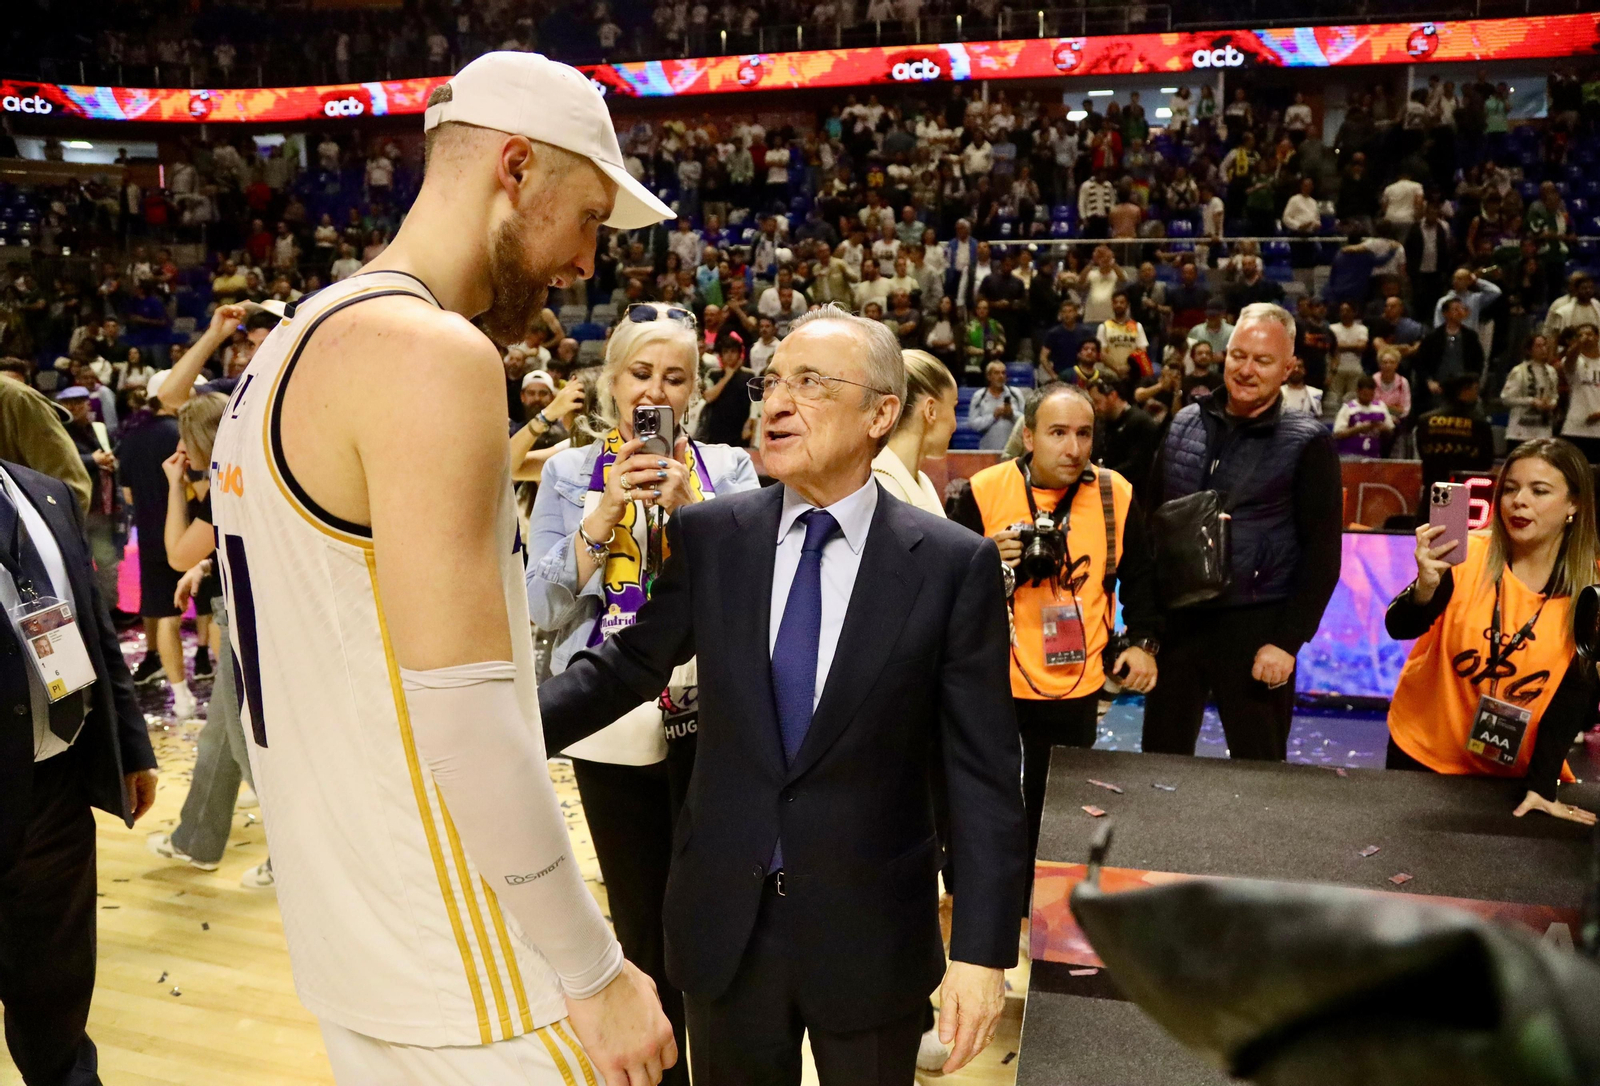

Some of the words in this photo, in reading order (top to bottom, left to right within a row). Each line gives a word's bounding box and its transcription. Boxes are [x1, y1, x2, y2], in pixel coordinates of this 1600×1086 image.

[1192, 45, 1244, 67] acb
[892, 58, 940, 80] acb
[2, 95, 52, 114] acb
[324, 96, 364, 117] acb
[1479, 730, 1510, 750] AAA
